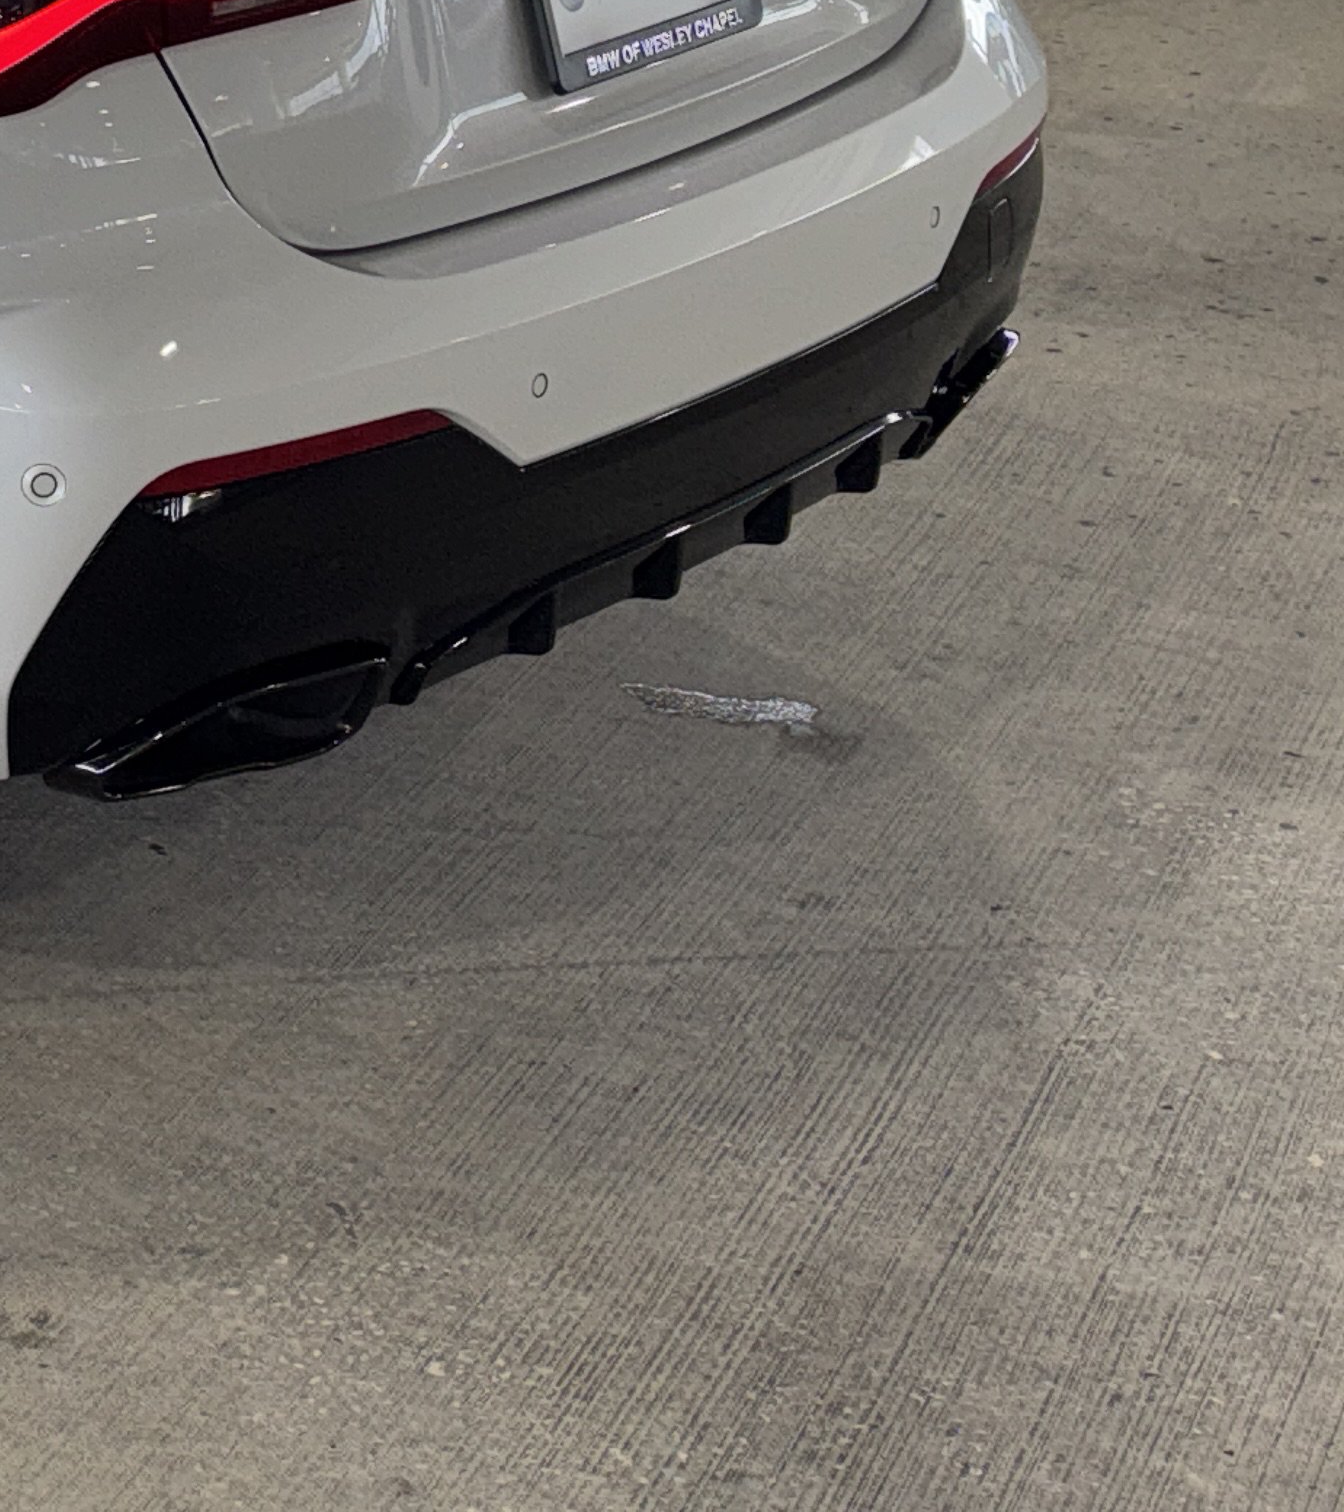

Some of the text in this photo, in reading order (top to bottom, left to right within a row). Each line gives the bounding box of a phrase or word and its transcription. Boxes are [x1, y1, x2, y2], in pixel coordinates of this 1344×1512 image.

[586, 8, 743, 76] BMW OF WESLEY CHAPEL
